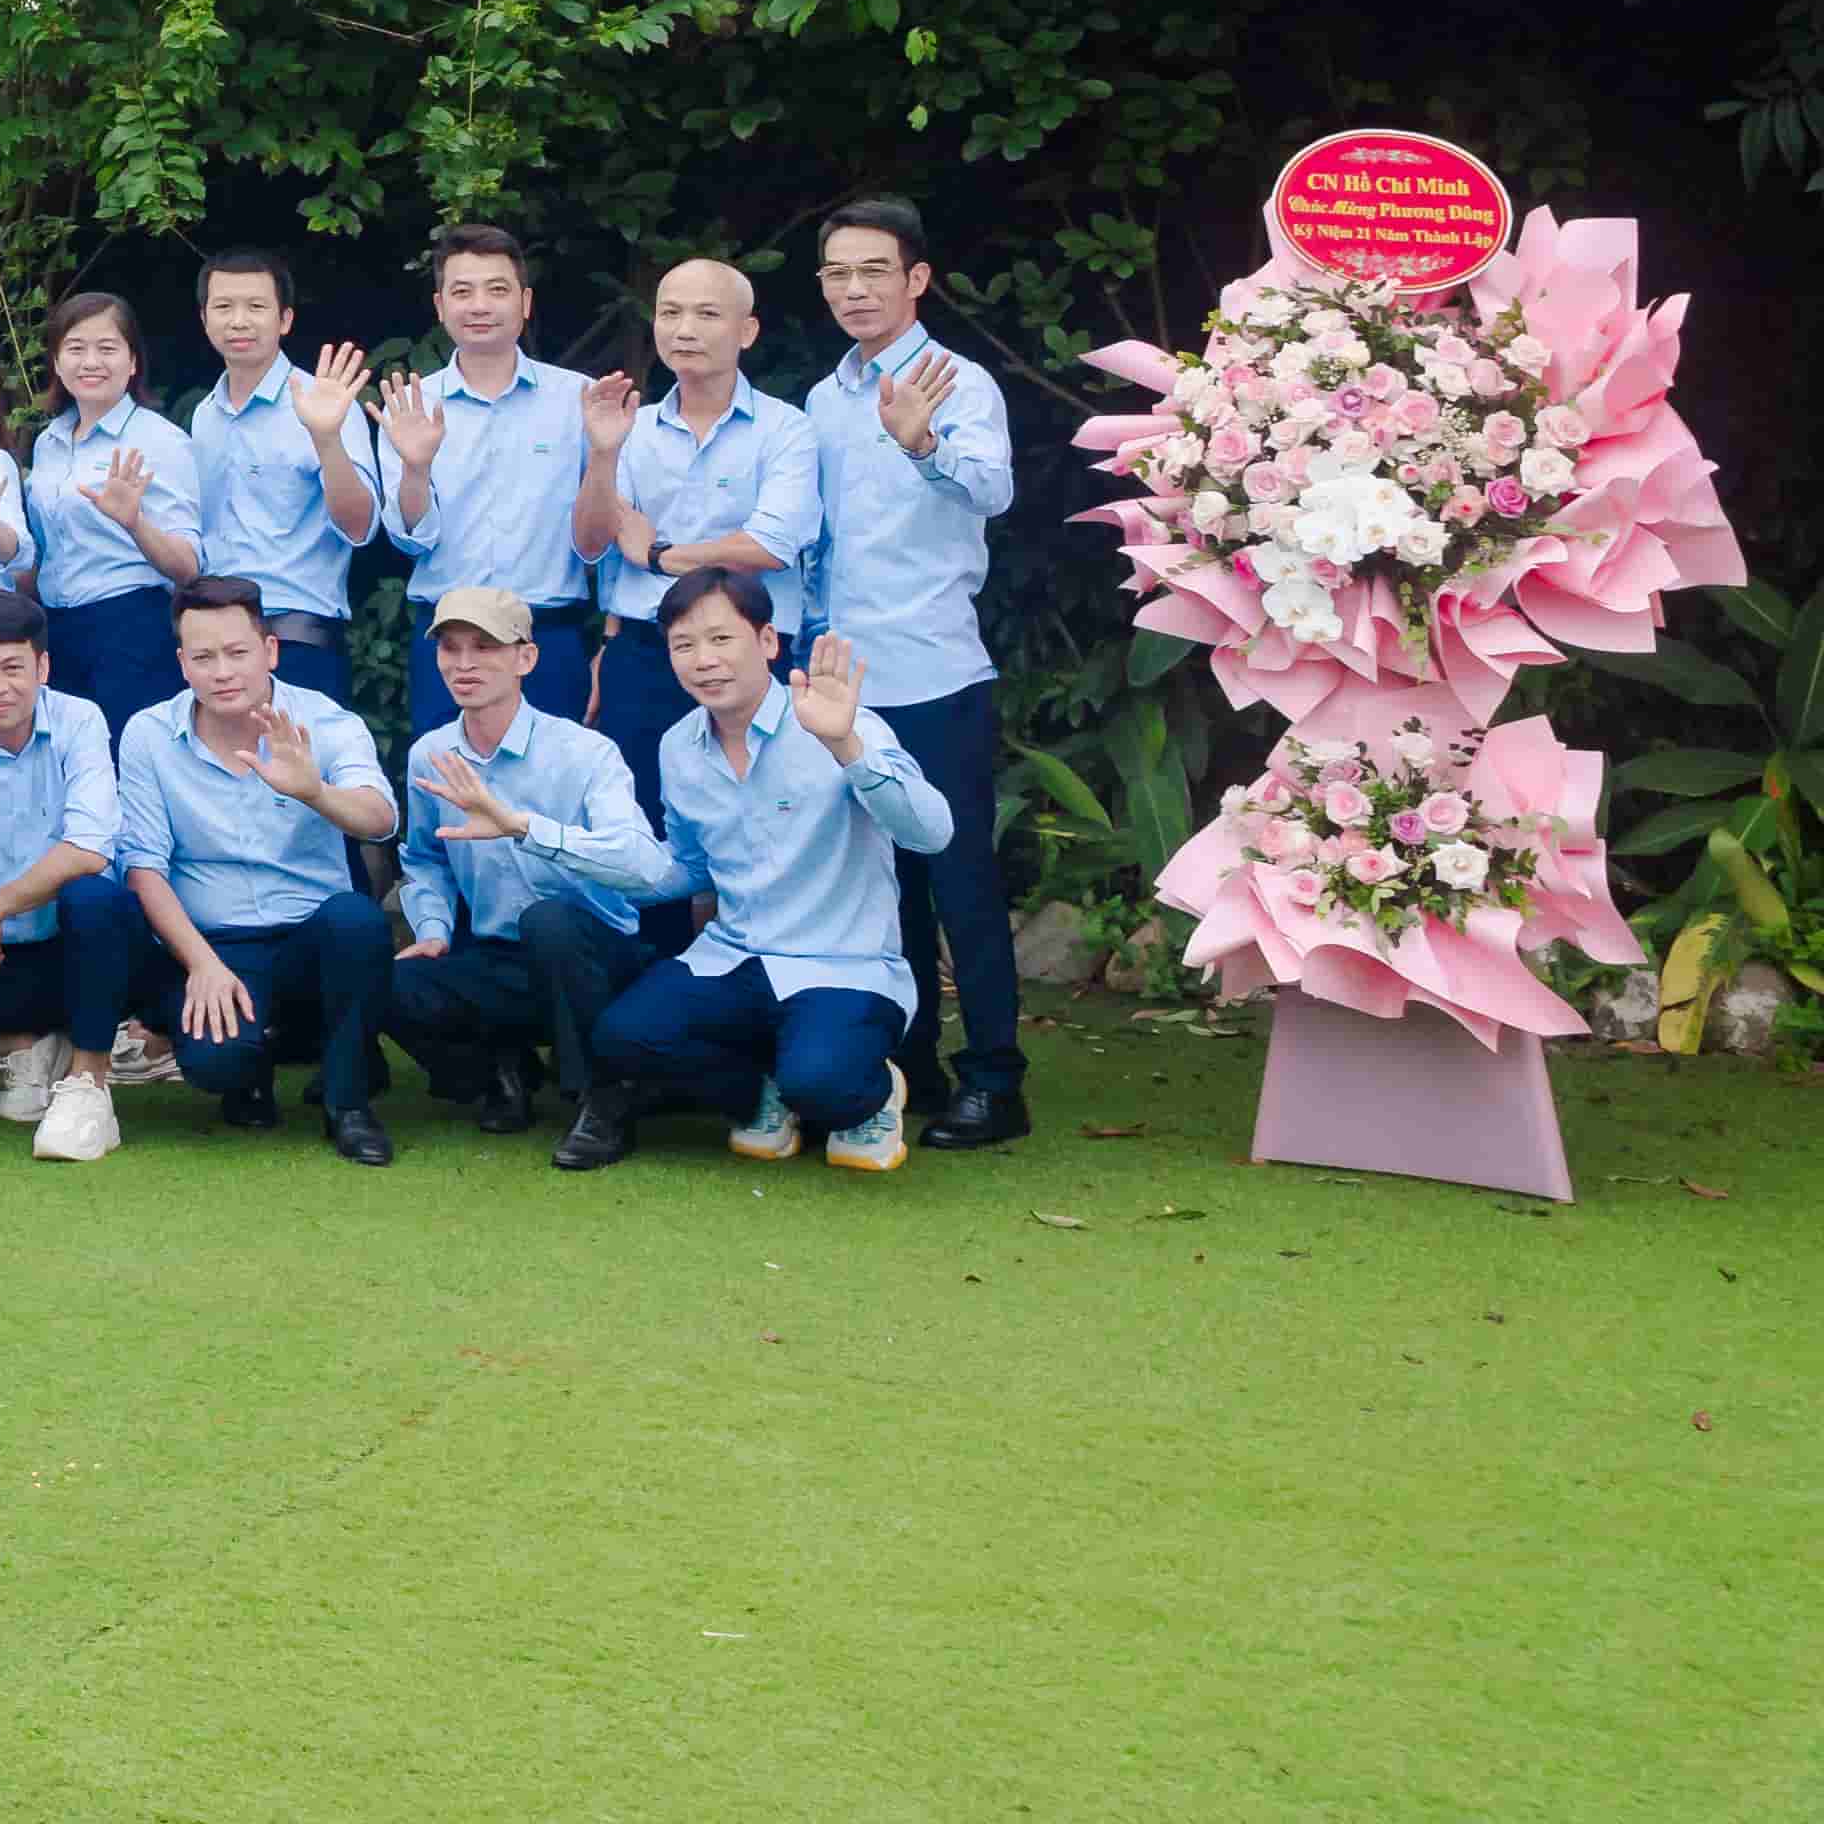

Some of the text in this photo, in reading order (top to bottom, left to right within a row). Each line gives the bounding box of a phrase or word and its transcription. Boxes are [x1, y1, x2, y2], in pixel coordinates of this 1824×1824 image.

[1306, 170, 1471, 197] CN Hồ Chí Minh
[1355, 226, 1371, 241] 21
